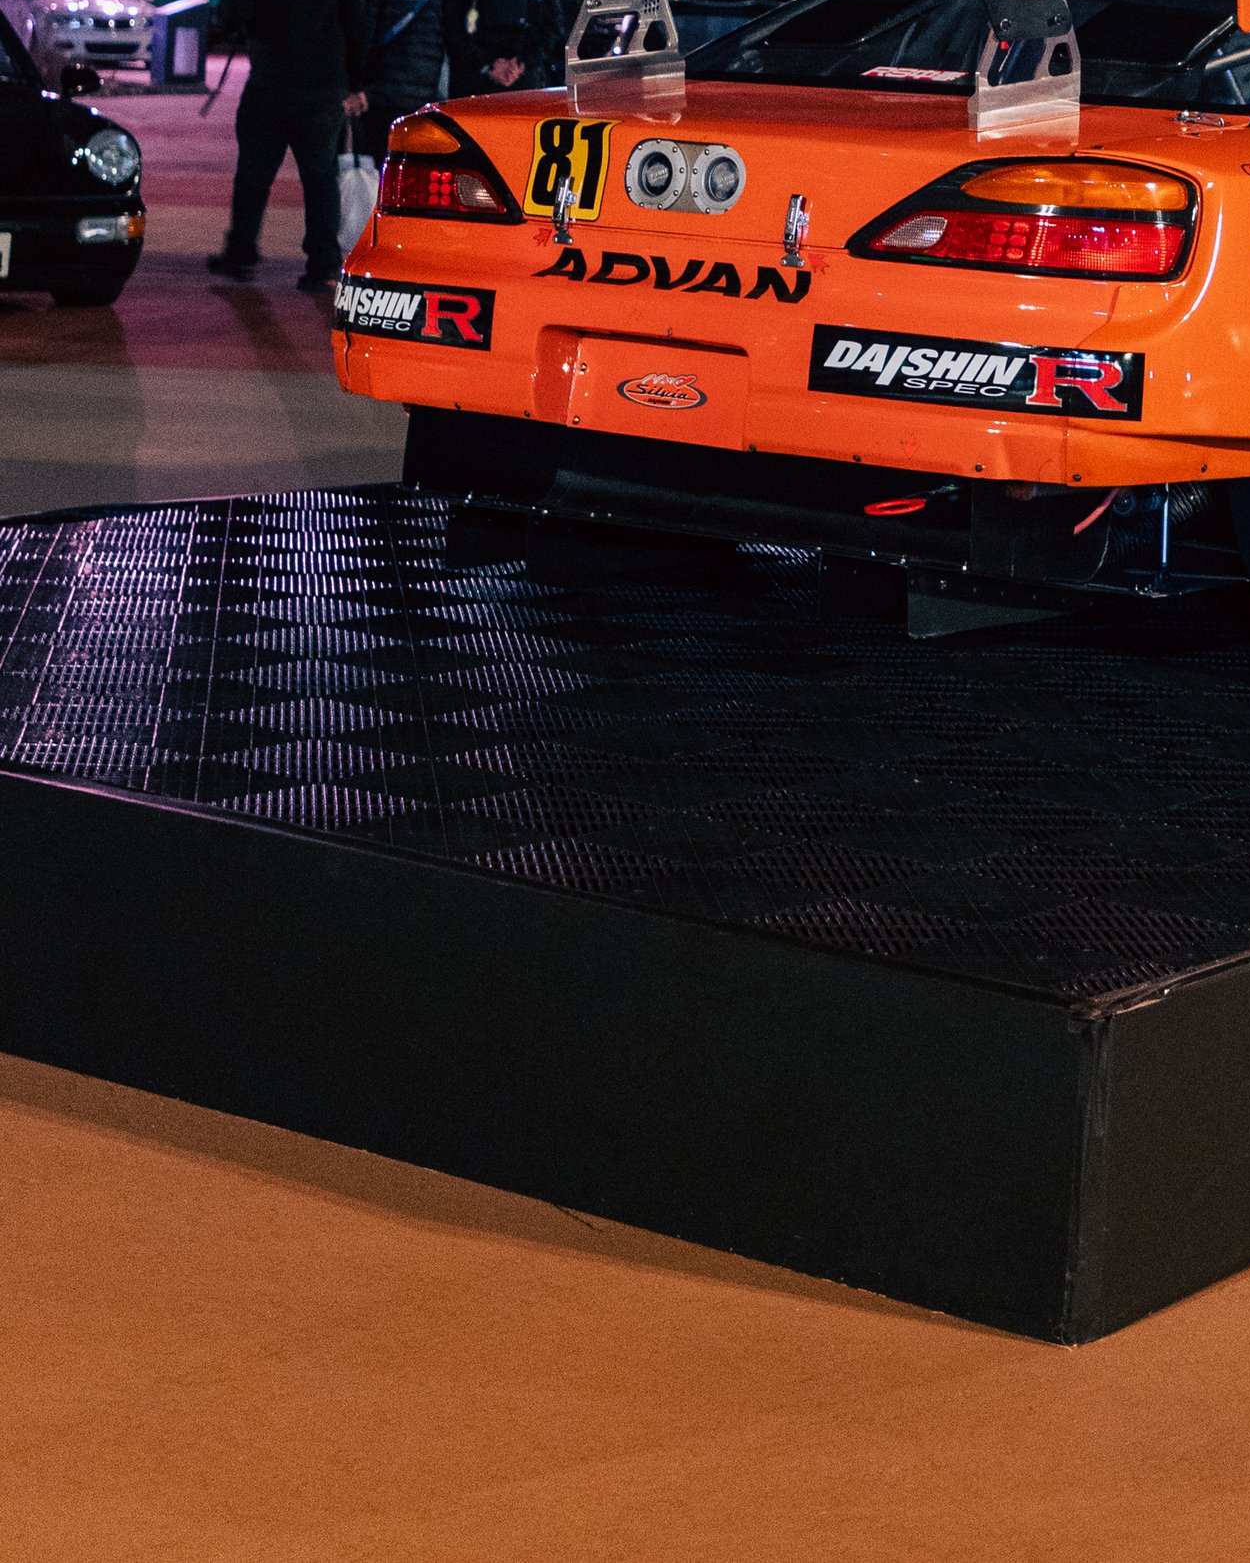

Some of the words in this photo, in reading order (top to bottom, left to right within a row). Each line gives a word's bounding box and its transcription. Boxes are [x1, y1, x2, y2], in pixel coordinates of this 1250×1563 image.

[531, 119, 612, 210] 81
[531, 248, 812, 304] ADVAN
[358, 316, 411, 332] SPEC
[421, 291, 483, 342] R
[824, 340, 1026, 386] DAISHIN
[903, 378, 1008, 398] SPEC
[1026, 354, 1128, 412] R
